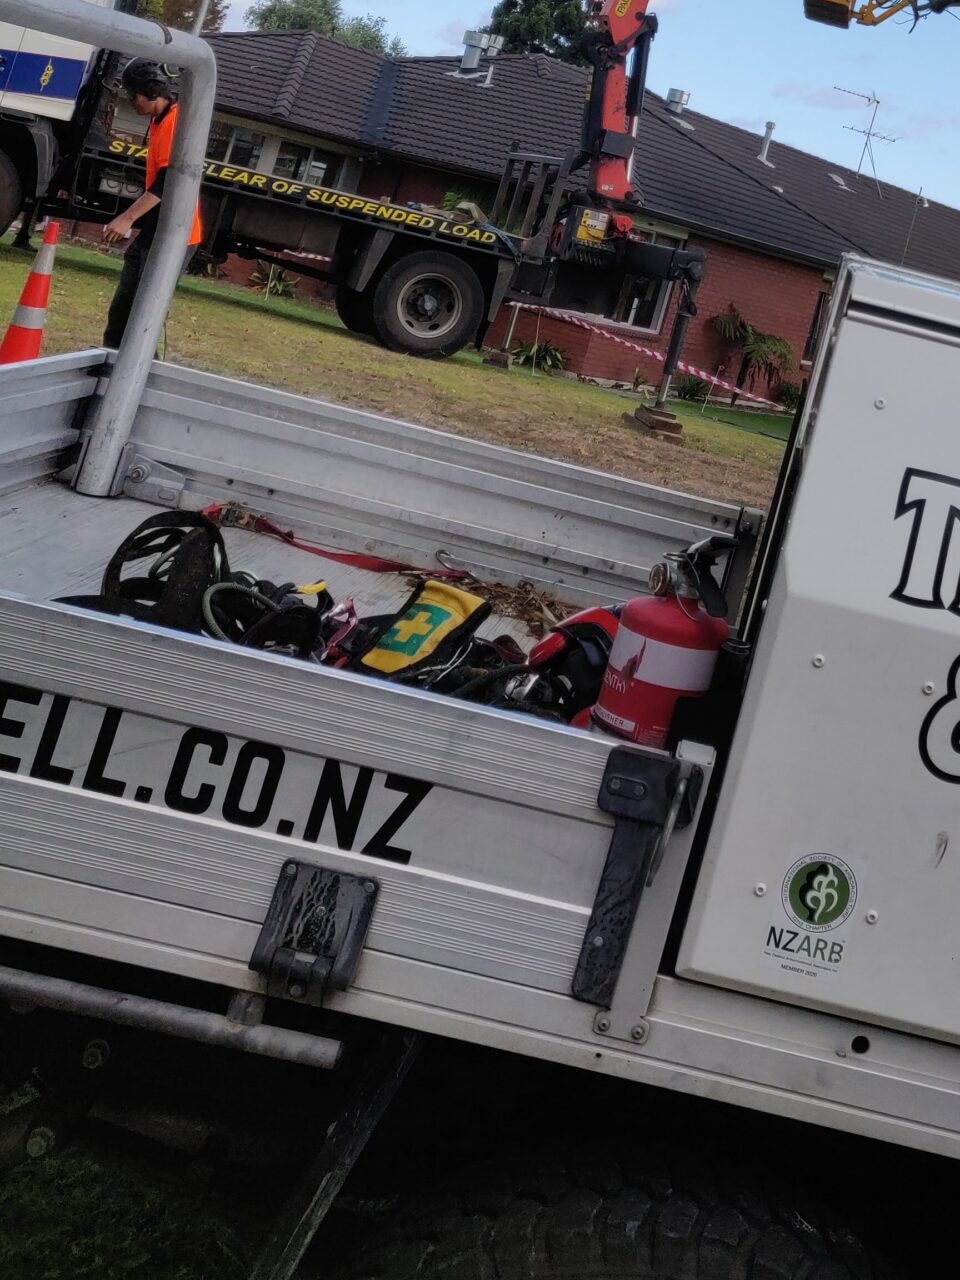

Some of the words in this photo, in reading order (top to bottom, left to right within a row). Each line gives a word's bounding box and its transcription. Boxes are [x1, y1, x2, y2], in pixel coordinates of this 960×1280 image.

[109, 140, 149, 158] STA
[271, 181, 303, 196] OF
[306, 188, 435, 228] SUSPENDED
[439, 222, 497, 244] LOAD
[766, 925, 844, 964] NZARB
